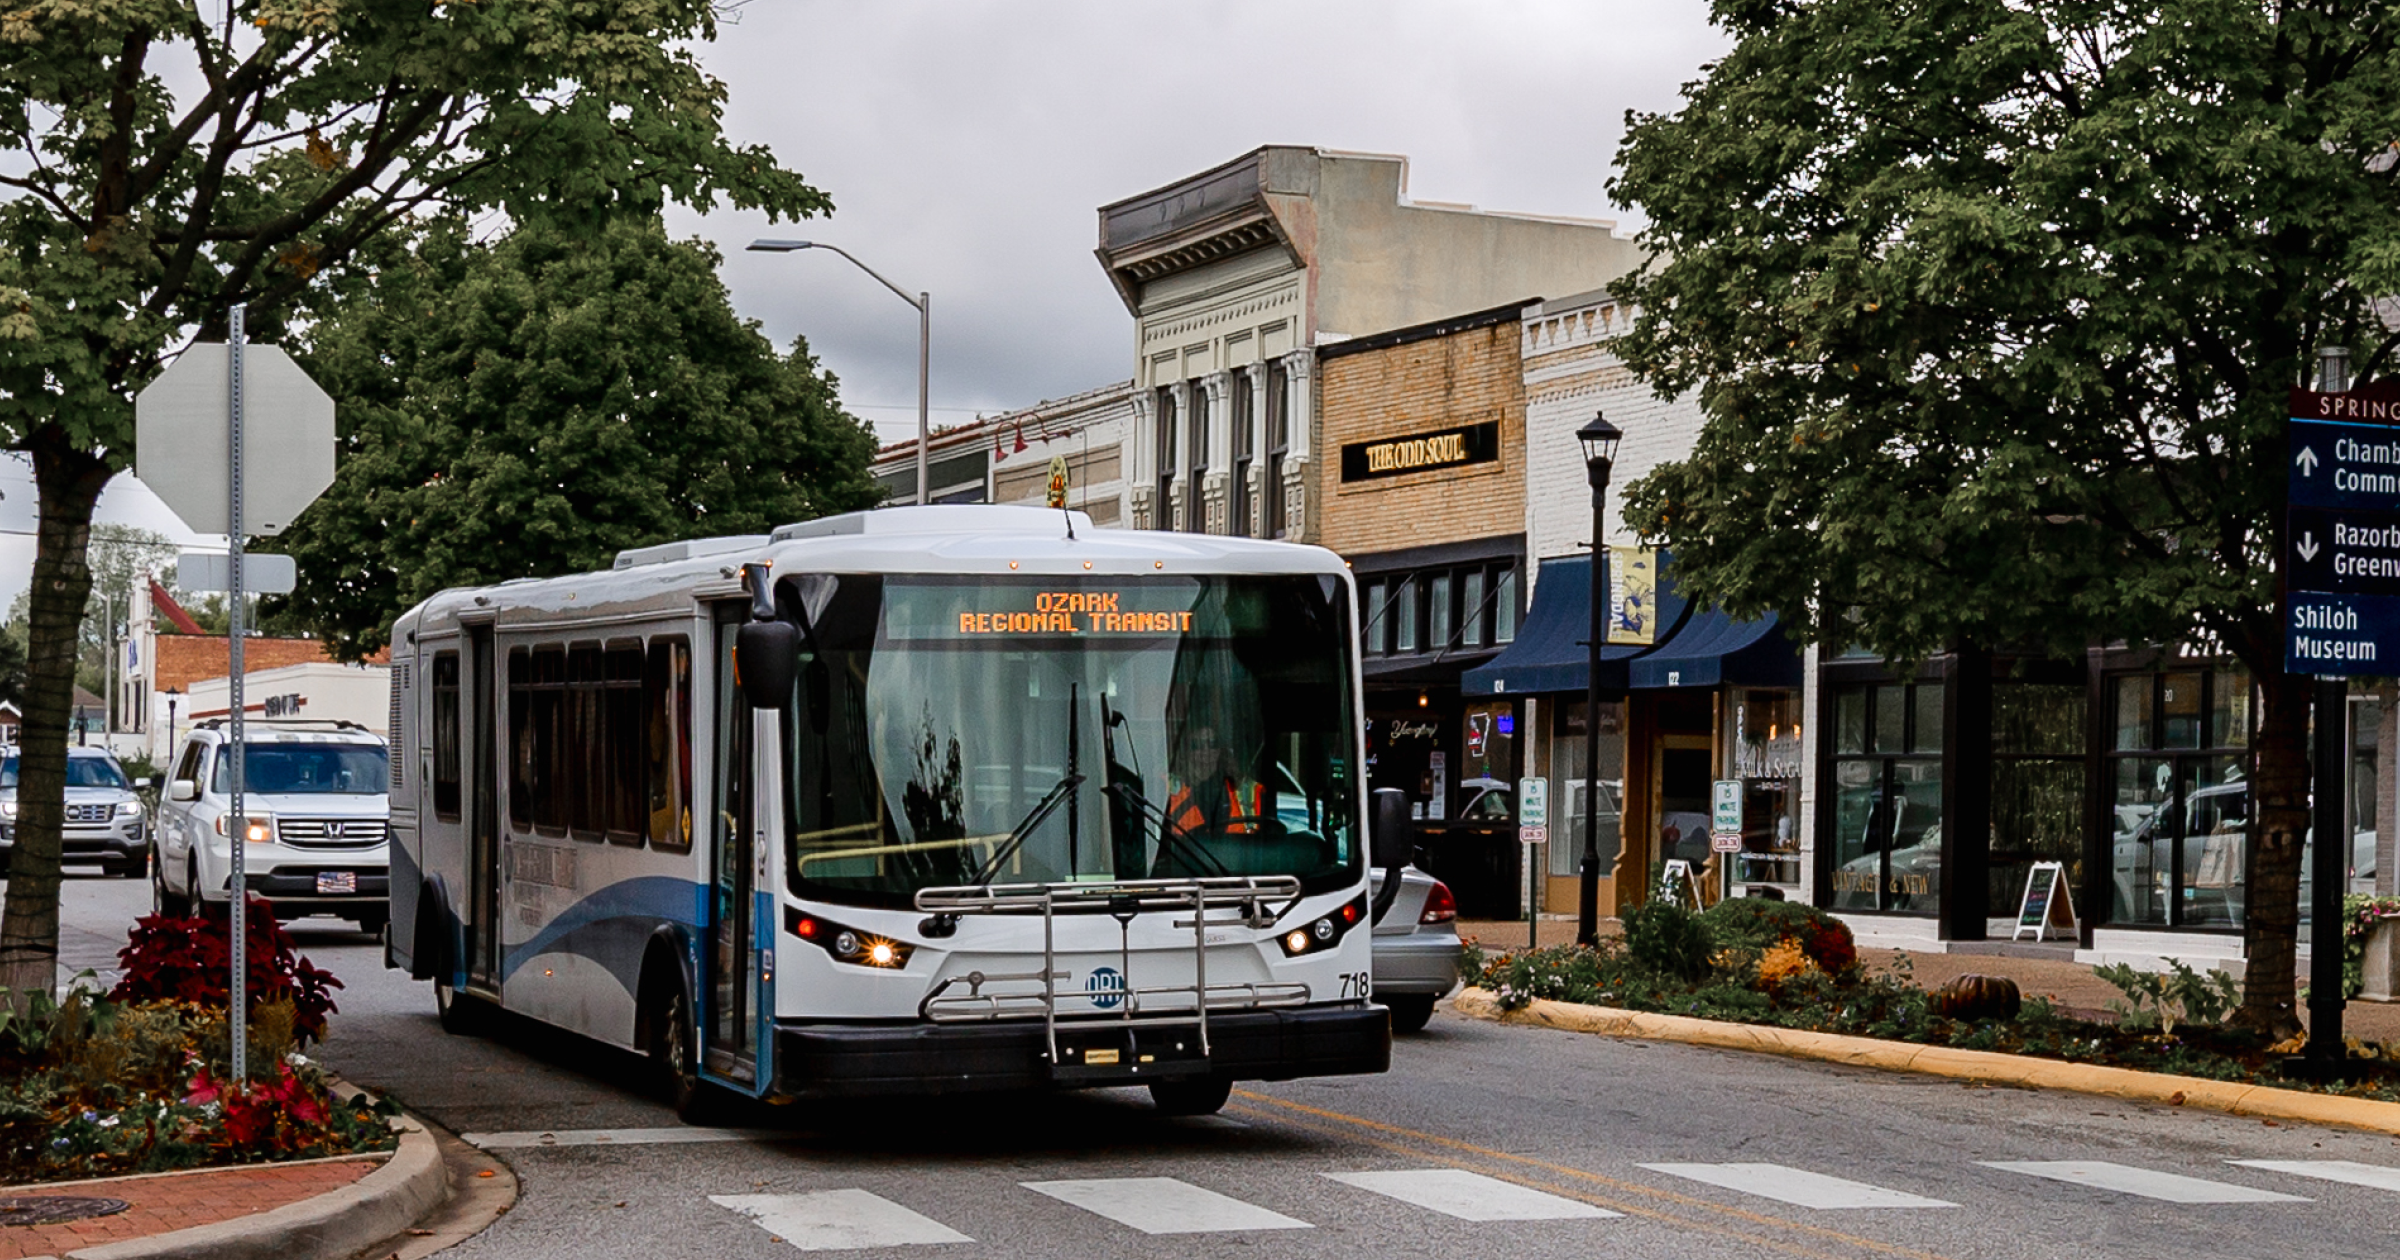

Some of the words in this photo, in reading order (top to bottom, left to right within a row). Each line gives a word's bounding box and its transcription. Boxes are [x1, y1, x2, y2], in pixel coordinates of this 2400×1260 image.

[1366, 443, 1396, 472] THE
[1395, 439, 1426, 468] ODD
[1426, 433, 1466, 464] SOUL
[2335, 437, 2400, 465] Chamb
[2334, 467, 2400, 493] Comm
[2334, 522, 2400, 549] Razorb
[1036, 592, 1119, 612] OZARK
[1610, 550, 1624, 638] SPRINGDALE
[959, 612, 1079, 633] REGIONAL
[1089, 612, 1193, 632] TRANSIT
[2294, 605, 2358, 631] Shiloh
[2294, 634, 2377, 661] Museum
[1338, 971, 1369, 998] 718
